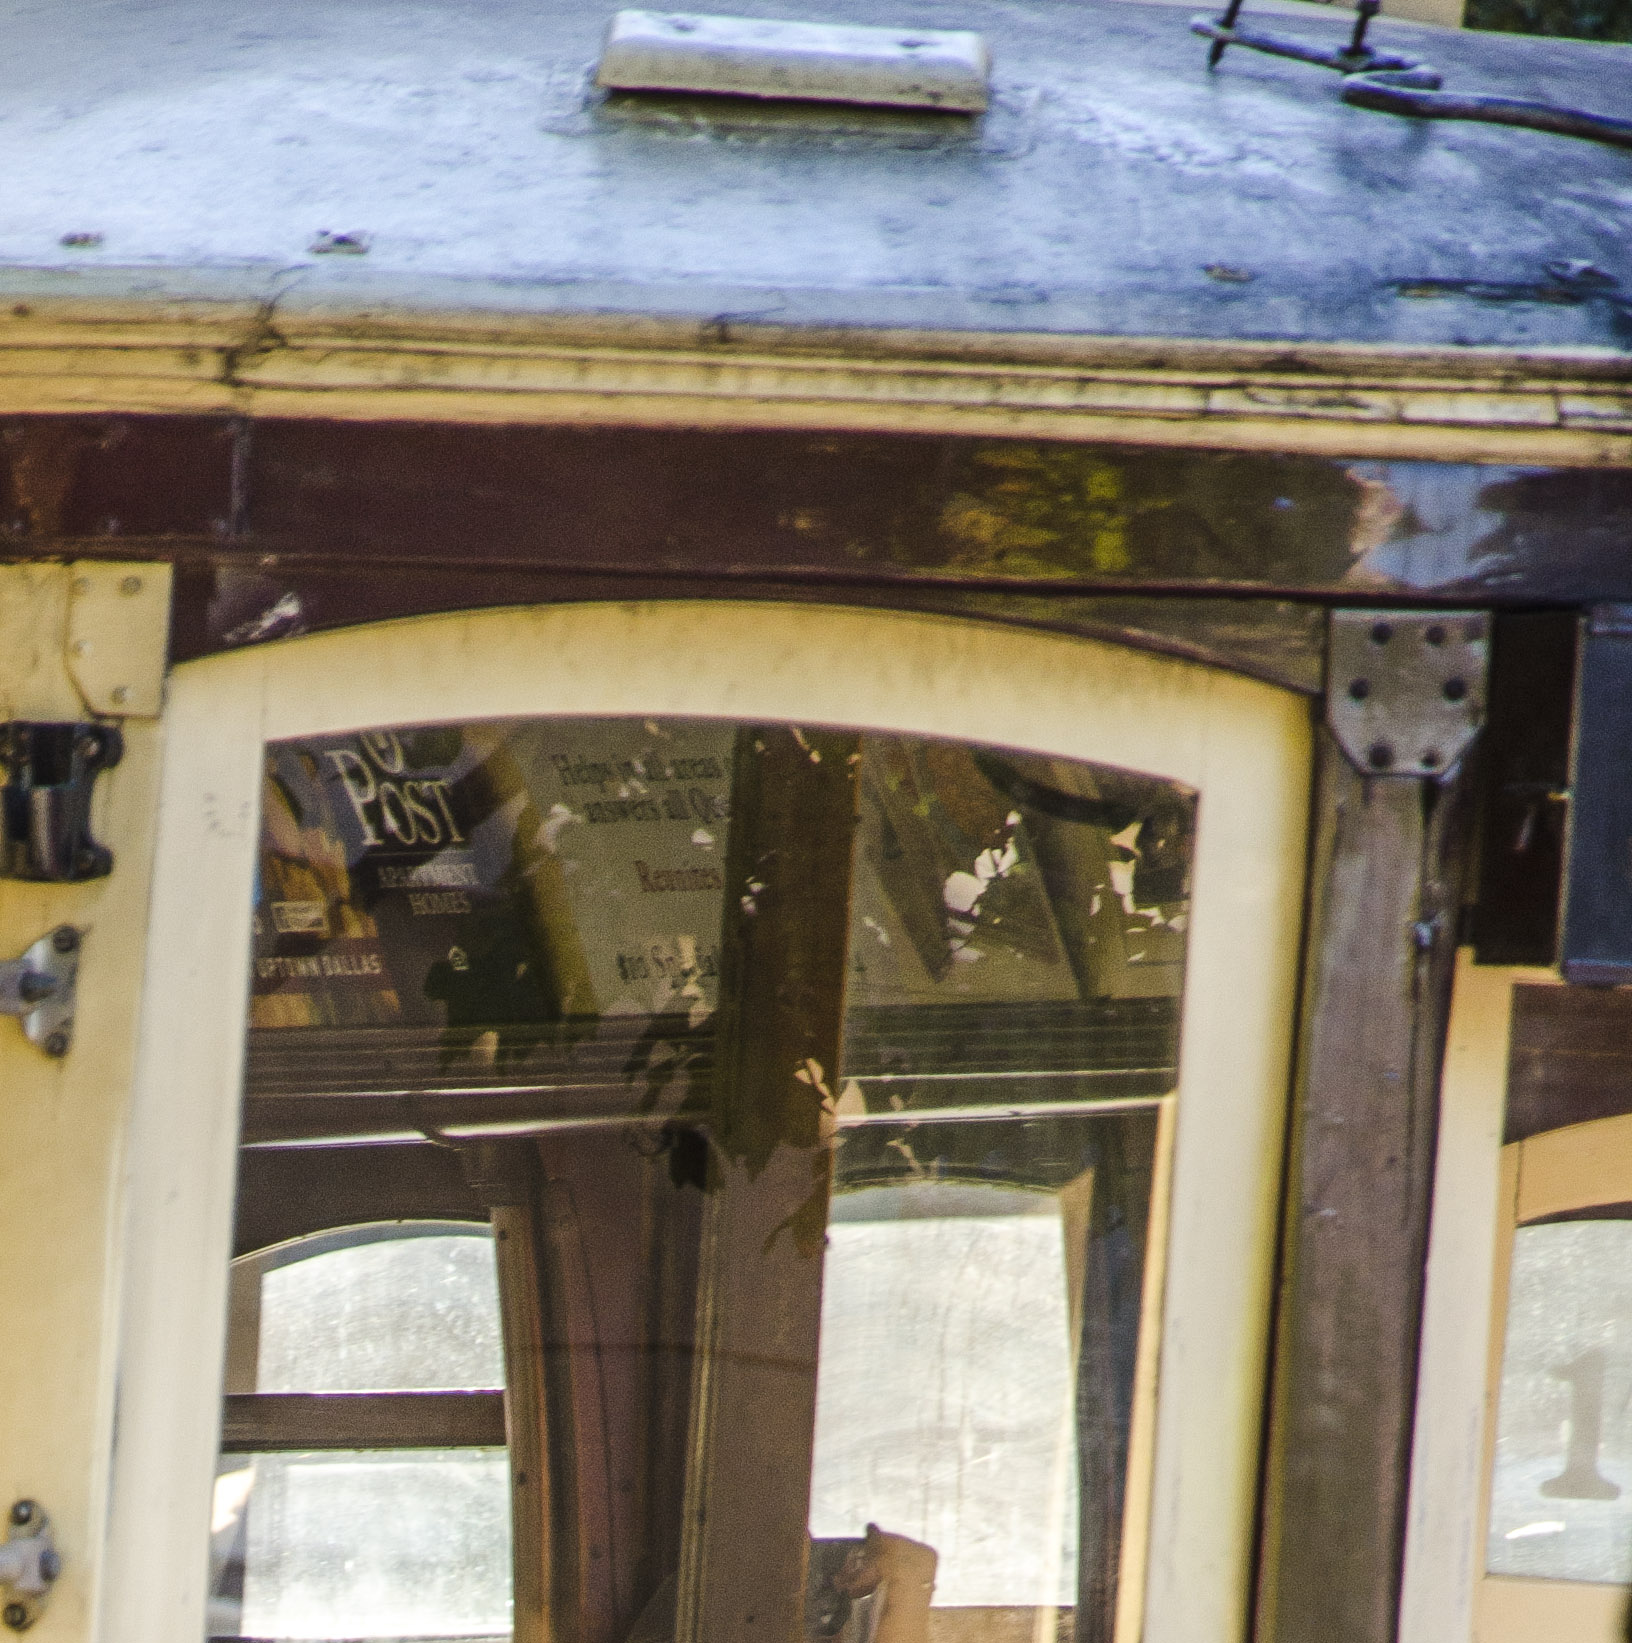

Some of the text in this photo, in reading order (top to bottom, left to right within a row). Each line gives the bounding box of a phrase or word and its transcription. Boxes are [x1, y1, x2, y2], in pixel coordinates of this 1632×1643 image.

[324, 750, 465, 846] POST
[411, 891, 471, 916] HOMES
[255, 953, 382, 978] UPTOWN DALLAS
